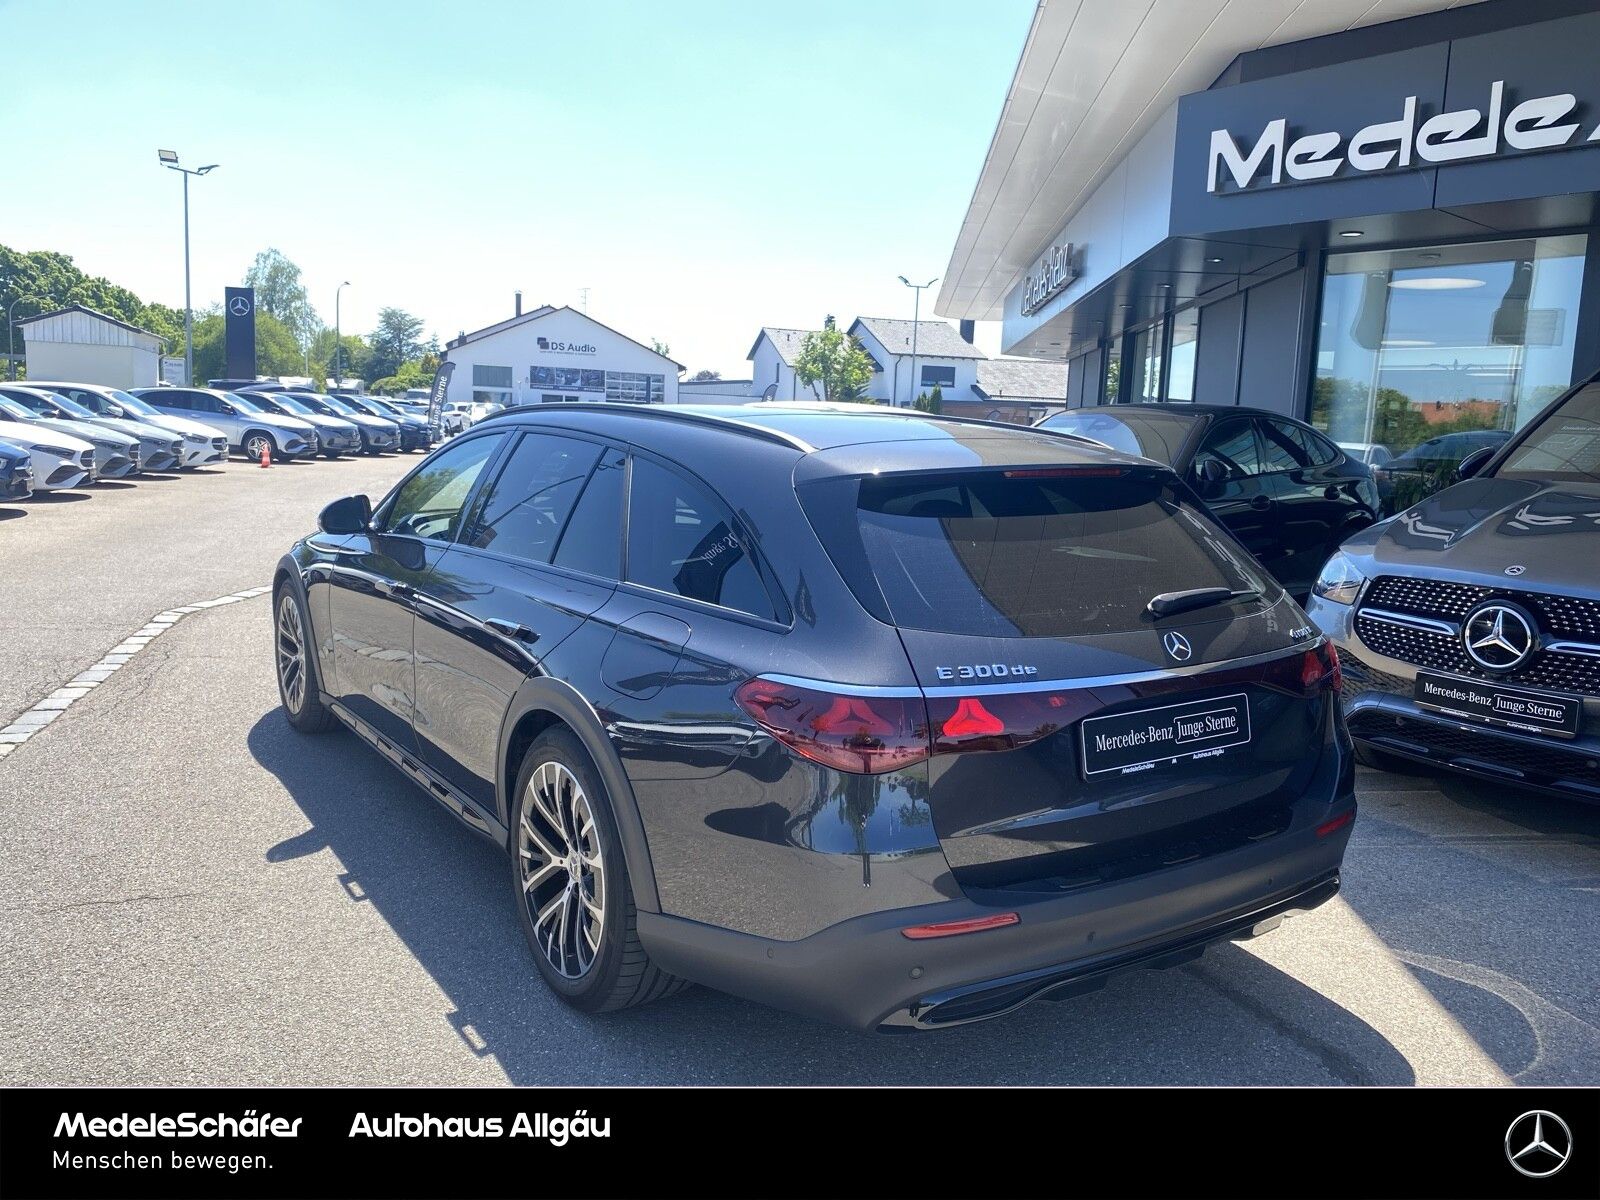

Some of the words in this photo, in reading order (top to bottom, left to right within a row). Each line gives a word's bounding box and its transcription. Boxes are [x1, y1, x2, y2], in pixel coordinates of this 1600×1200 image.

[1207, 80, 1600, 192] Medele
[551, 342, 565, 351] DS
[568, 343, 597, 353] Audio
[434, 376, 448, 403] Sterne
[936, 666, 954, 679] E
[958, 664, 1009, 679] 300
[1011, 665, 1038, 676] de
[1424, 682, 1492, 706] Mercedes-Benz
[1496, 696, 1525, 713] Junge
[1527, 702, 1562, 719] Sterne
[1095, 726, 1174, 752] Mercedes-Benz
[1177, 720, 1204, 740] Junge
[1205, 714, 1236, 733] Sterne
